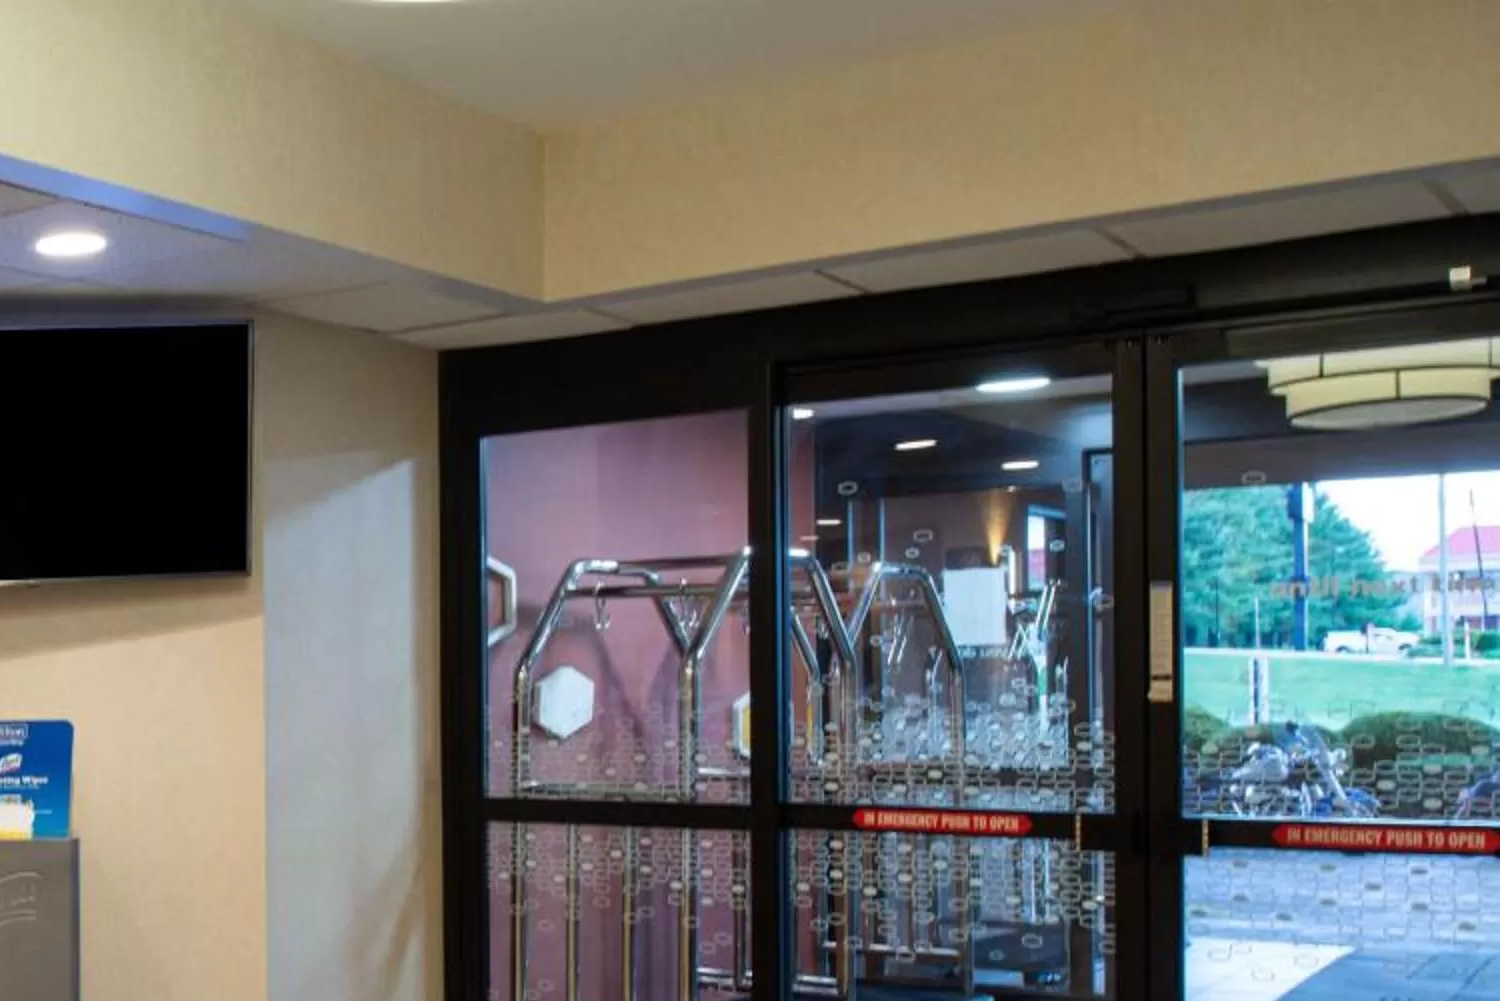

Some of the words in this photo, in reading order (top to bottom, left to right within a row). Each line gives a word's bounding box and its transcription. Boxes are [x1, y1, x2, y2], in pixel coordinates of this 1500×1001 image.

[863, 811, 875, 827] IN
[877, 811, 938, 829] EMERGENCY
[941, 814, 971, 830] PUSH
[973, 815, 987, 831] TO
[989, 816, 1019, 832] OPEN
[1287, 827, 1300, 842] IN
[1304, 827, 1383, 845] EMERGENCY
[1386, 830, 1423, 846] PUSH
[1427, 831, 1445, 848] TO
[1448, 832, 1486, 849] OPEN
